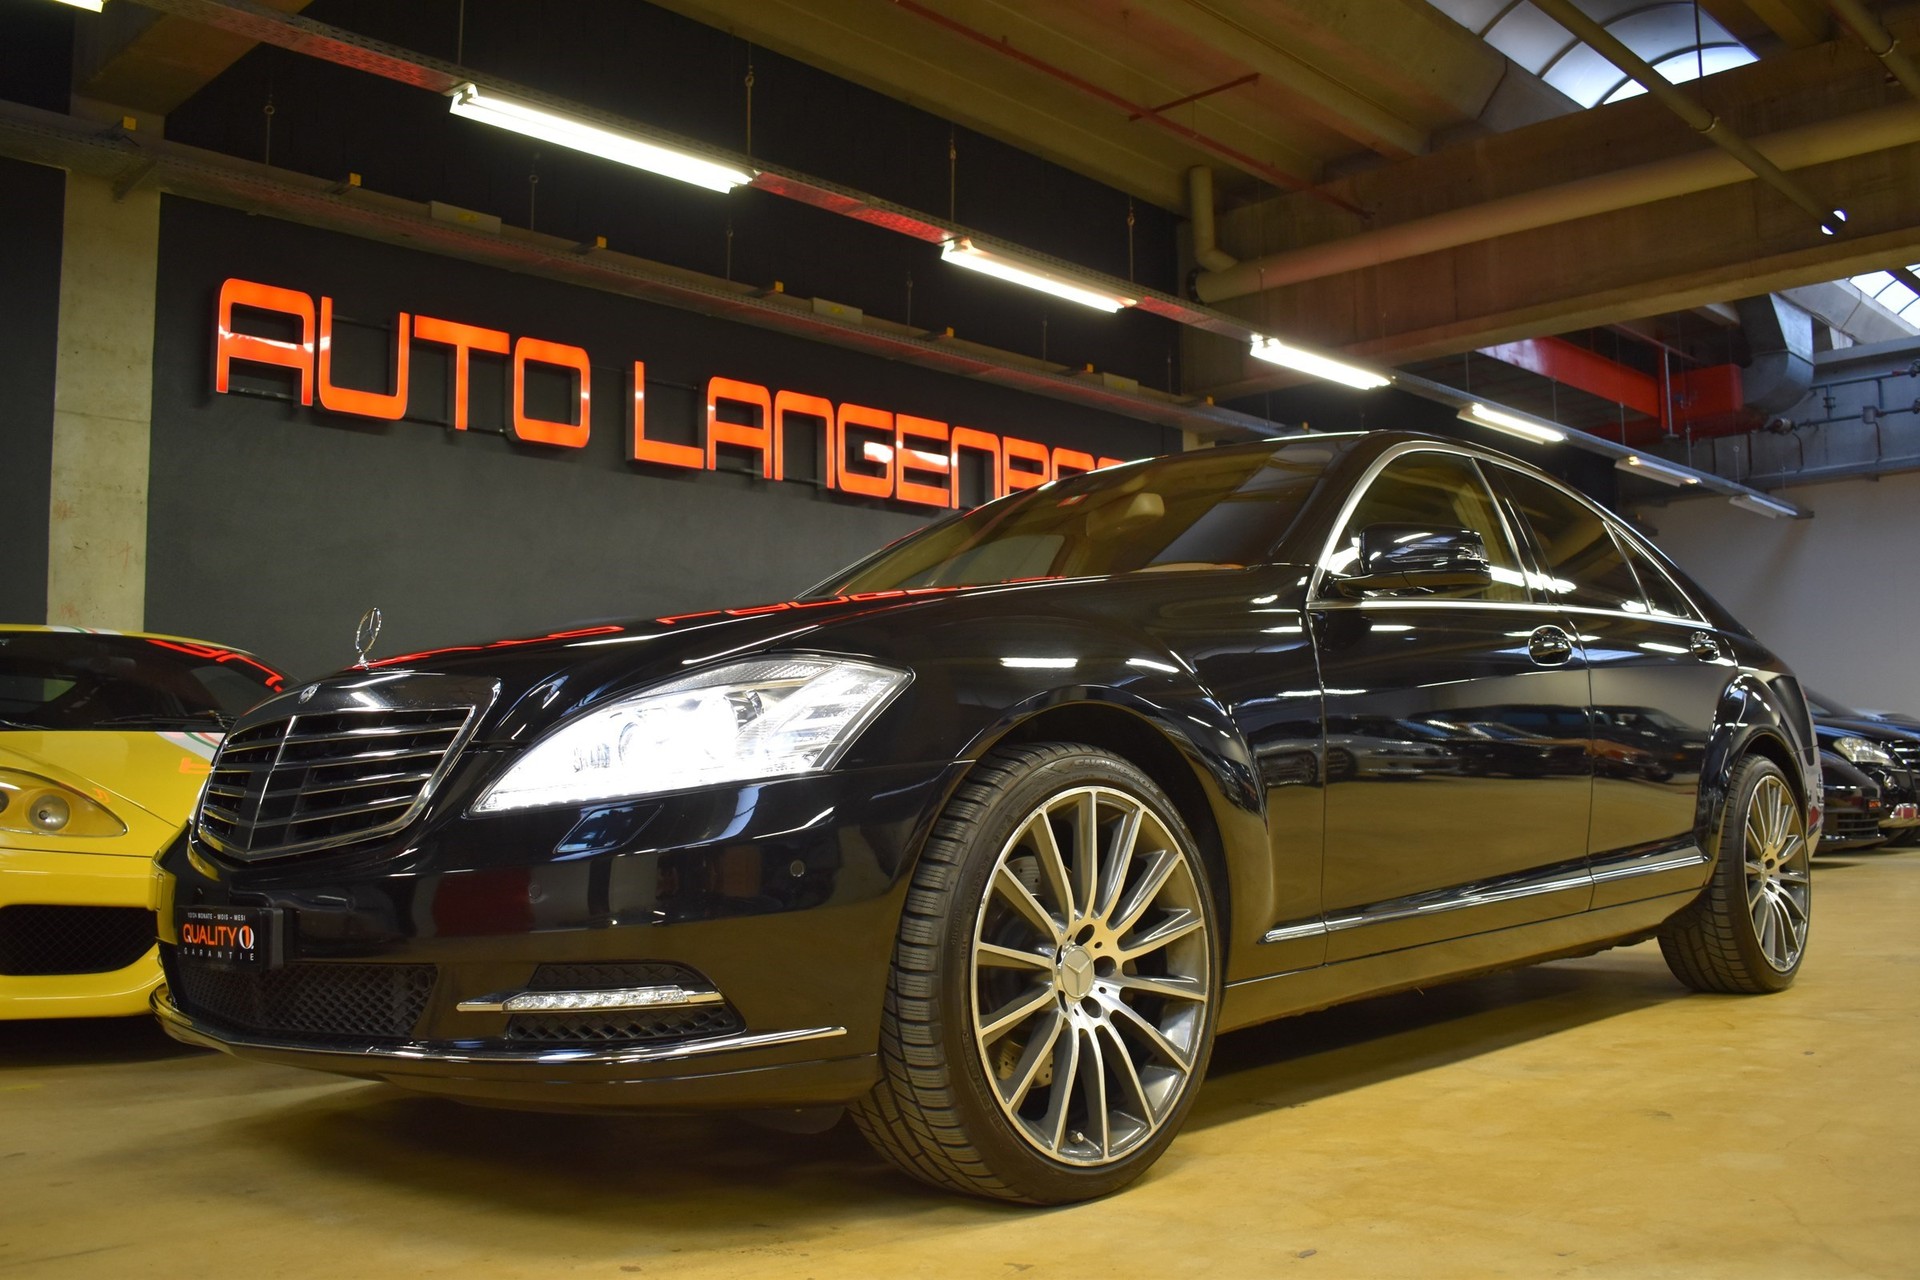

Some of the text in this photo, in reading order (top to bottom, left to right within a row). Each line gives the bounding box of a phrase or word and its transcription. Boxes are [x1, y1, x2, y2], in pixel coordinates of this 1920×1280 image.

[215, 277, 592, 449] AUTO
[183, 923, 238, 947] QUALITY
[184, 947, 255, 961] GARANTIE
